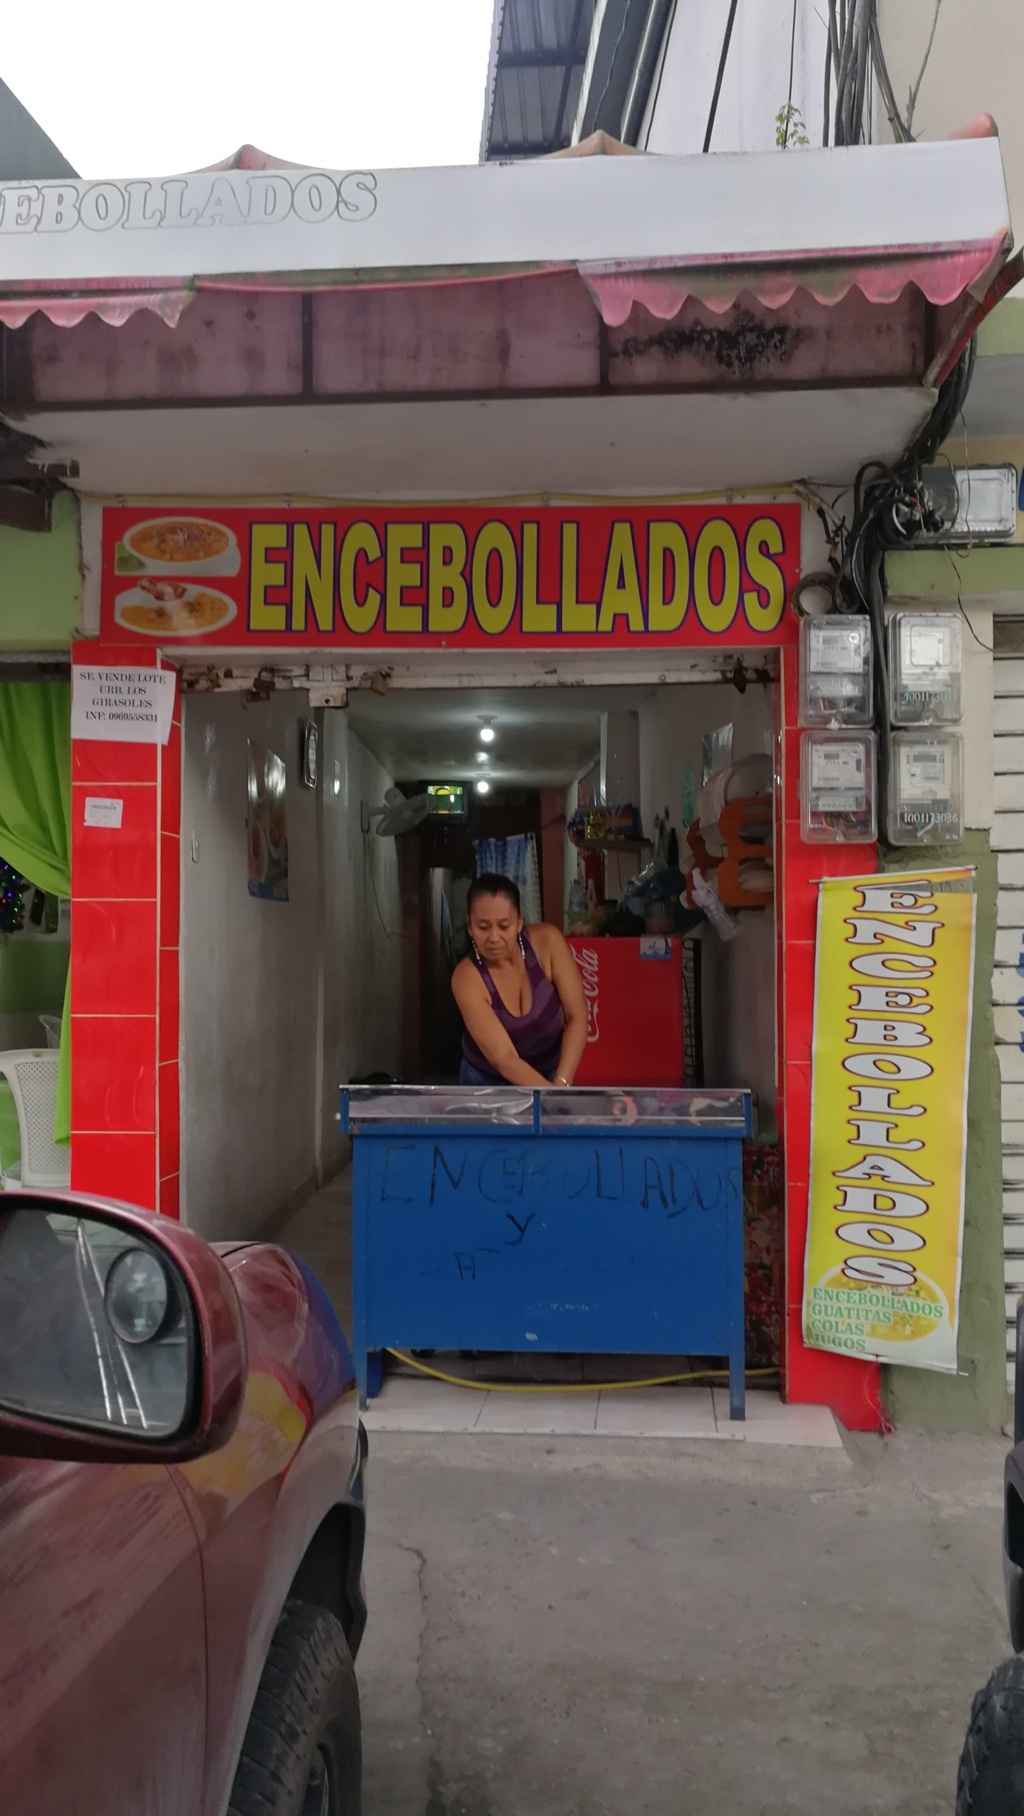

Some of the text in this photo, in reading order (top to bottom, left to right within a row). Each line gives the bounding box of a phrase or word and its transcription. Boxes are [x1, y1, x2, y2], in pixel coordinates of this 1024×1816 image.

[0, 172, 378, 235] EBOLLADOS
[247, 516, 788, 636] ENCEBOLLADOS
[80, 671, 167, 684] SE VENDE LOTE
[127, 686, 147, 695] LOS
[92, 698, 153, 709] GIRASOLES
[832, 879, 945, 1287] ENCEBOLLADOS
[811, 1302, 893, 1324] GUATITAS
[812, 1287, 944, 1319] ENCEBOLLADOS
[810, 1319, 866, 1337] COLAS
[811, 1334, 866, 1352] JUGOS
